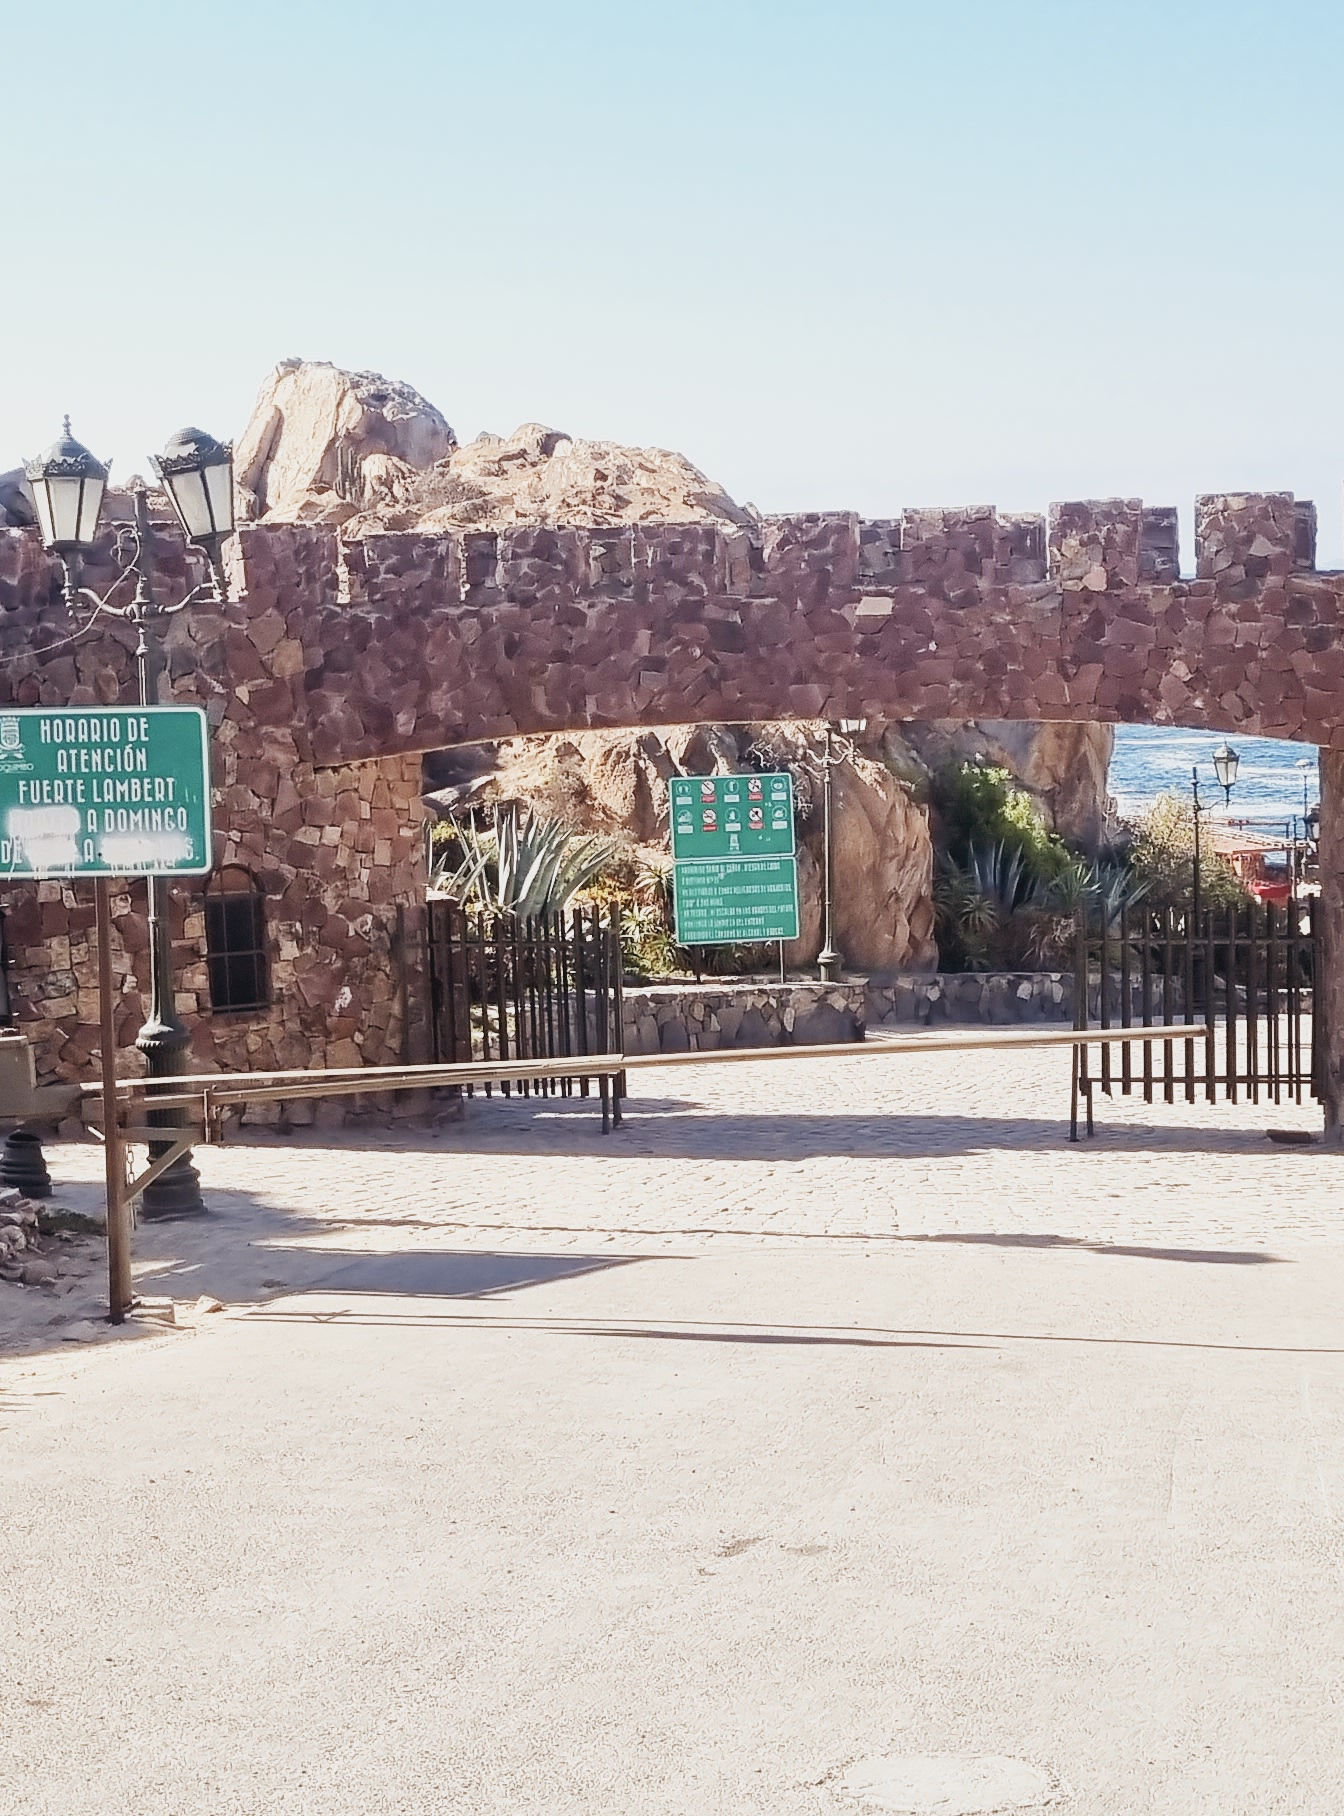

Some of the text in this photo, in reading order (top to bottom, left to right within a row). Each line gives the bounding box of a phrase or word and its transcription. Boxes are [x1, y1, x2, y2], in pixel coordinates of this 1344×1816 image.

[40, 717, 149, 743] HORARIO DE
[57, 744, 147, 772] ATENCIÓN
[19, 777, 175, 803] FUERTE LAMBERT
[87, 808, 97, 832] A
[105, 807, 187, 831] DOMINGO
[1, 840, 22, 863] DE
[84, 839, 94, 862] A
